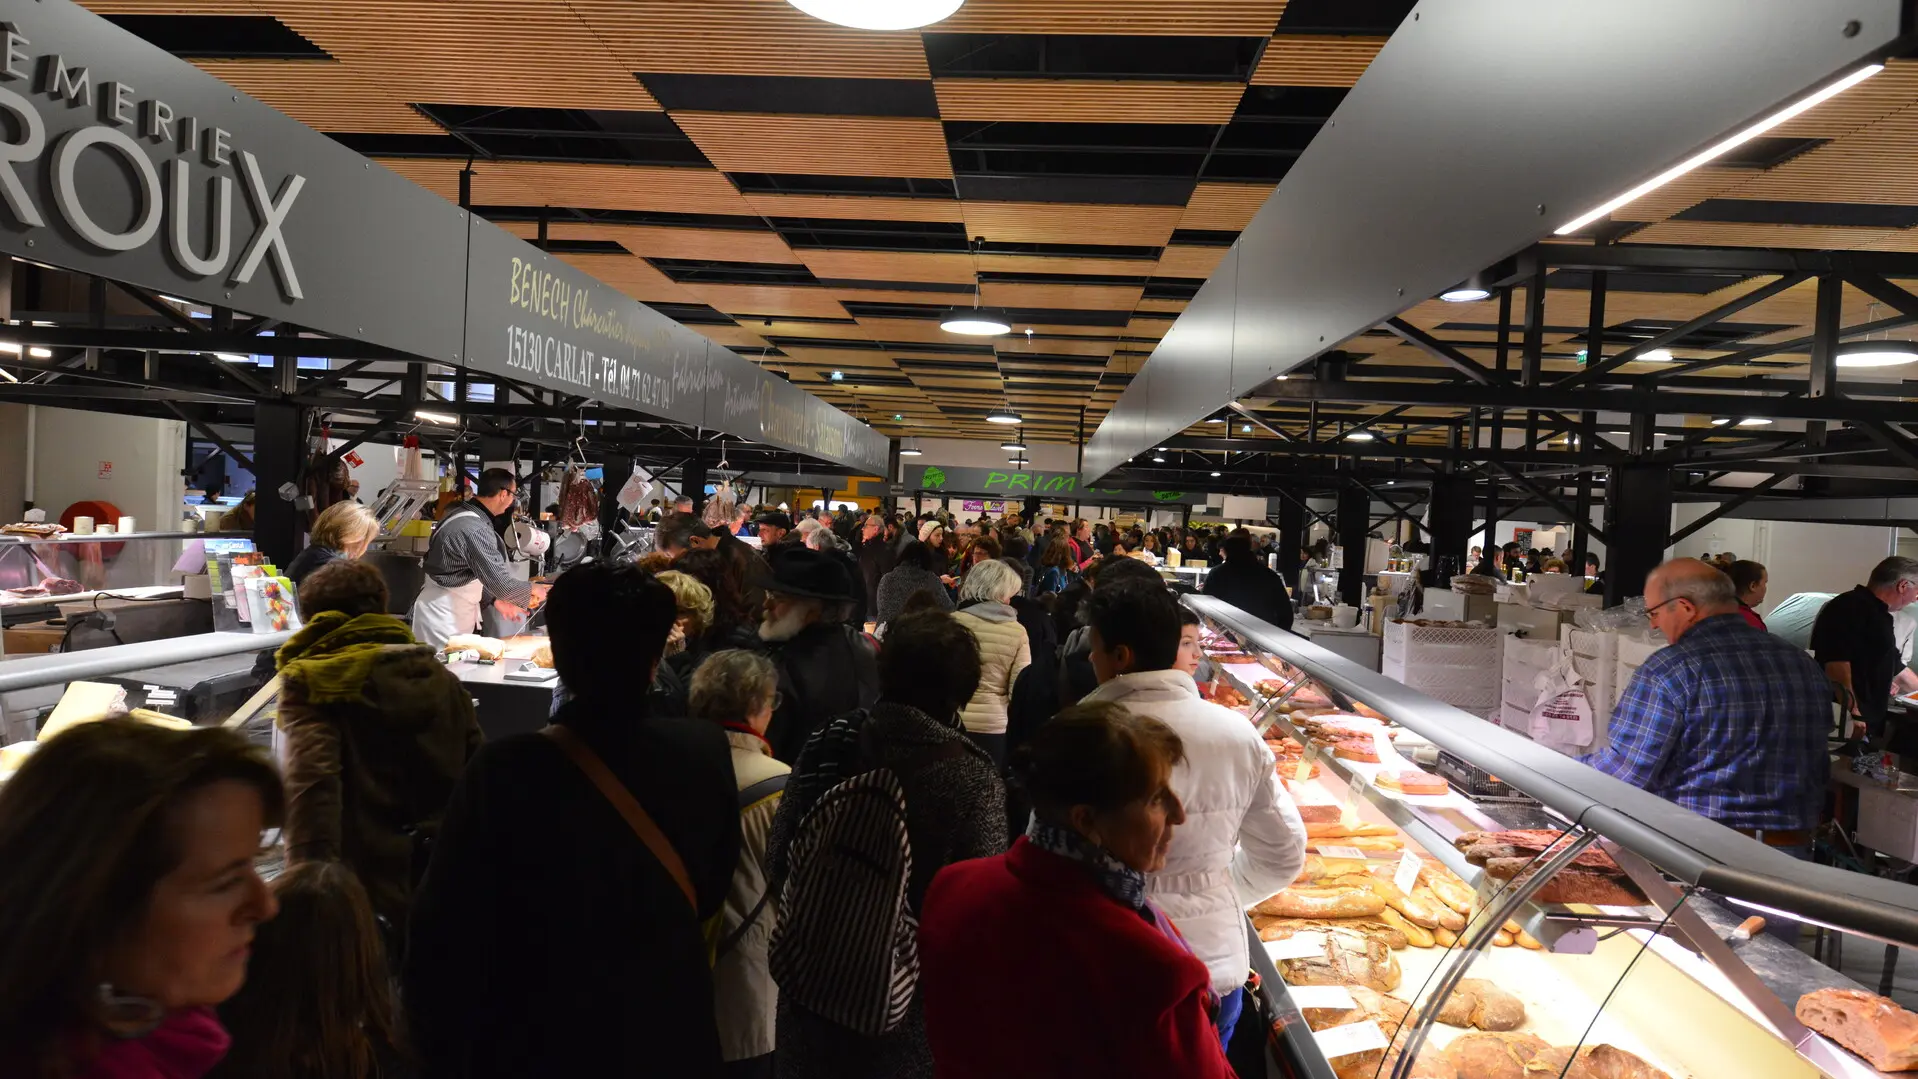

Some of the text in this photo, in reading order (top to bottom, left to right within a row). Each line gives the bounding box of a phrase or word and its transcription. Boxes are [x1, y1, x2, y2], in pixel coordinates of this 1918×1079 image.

[510, 256, 571, 329] BENECH
[506, 324, 542, 374] 15130
[544, 336, 595, 388] CARLAT
[601, 356, 619, 395] Tél.
[632, 368, 641, 402] 71
